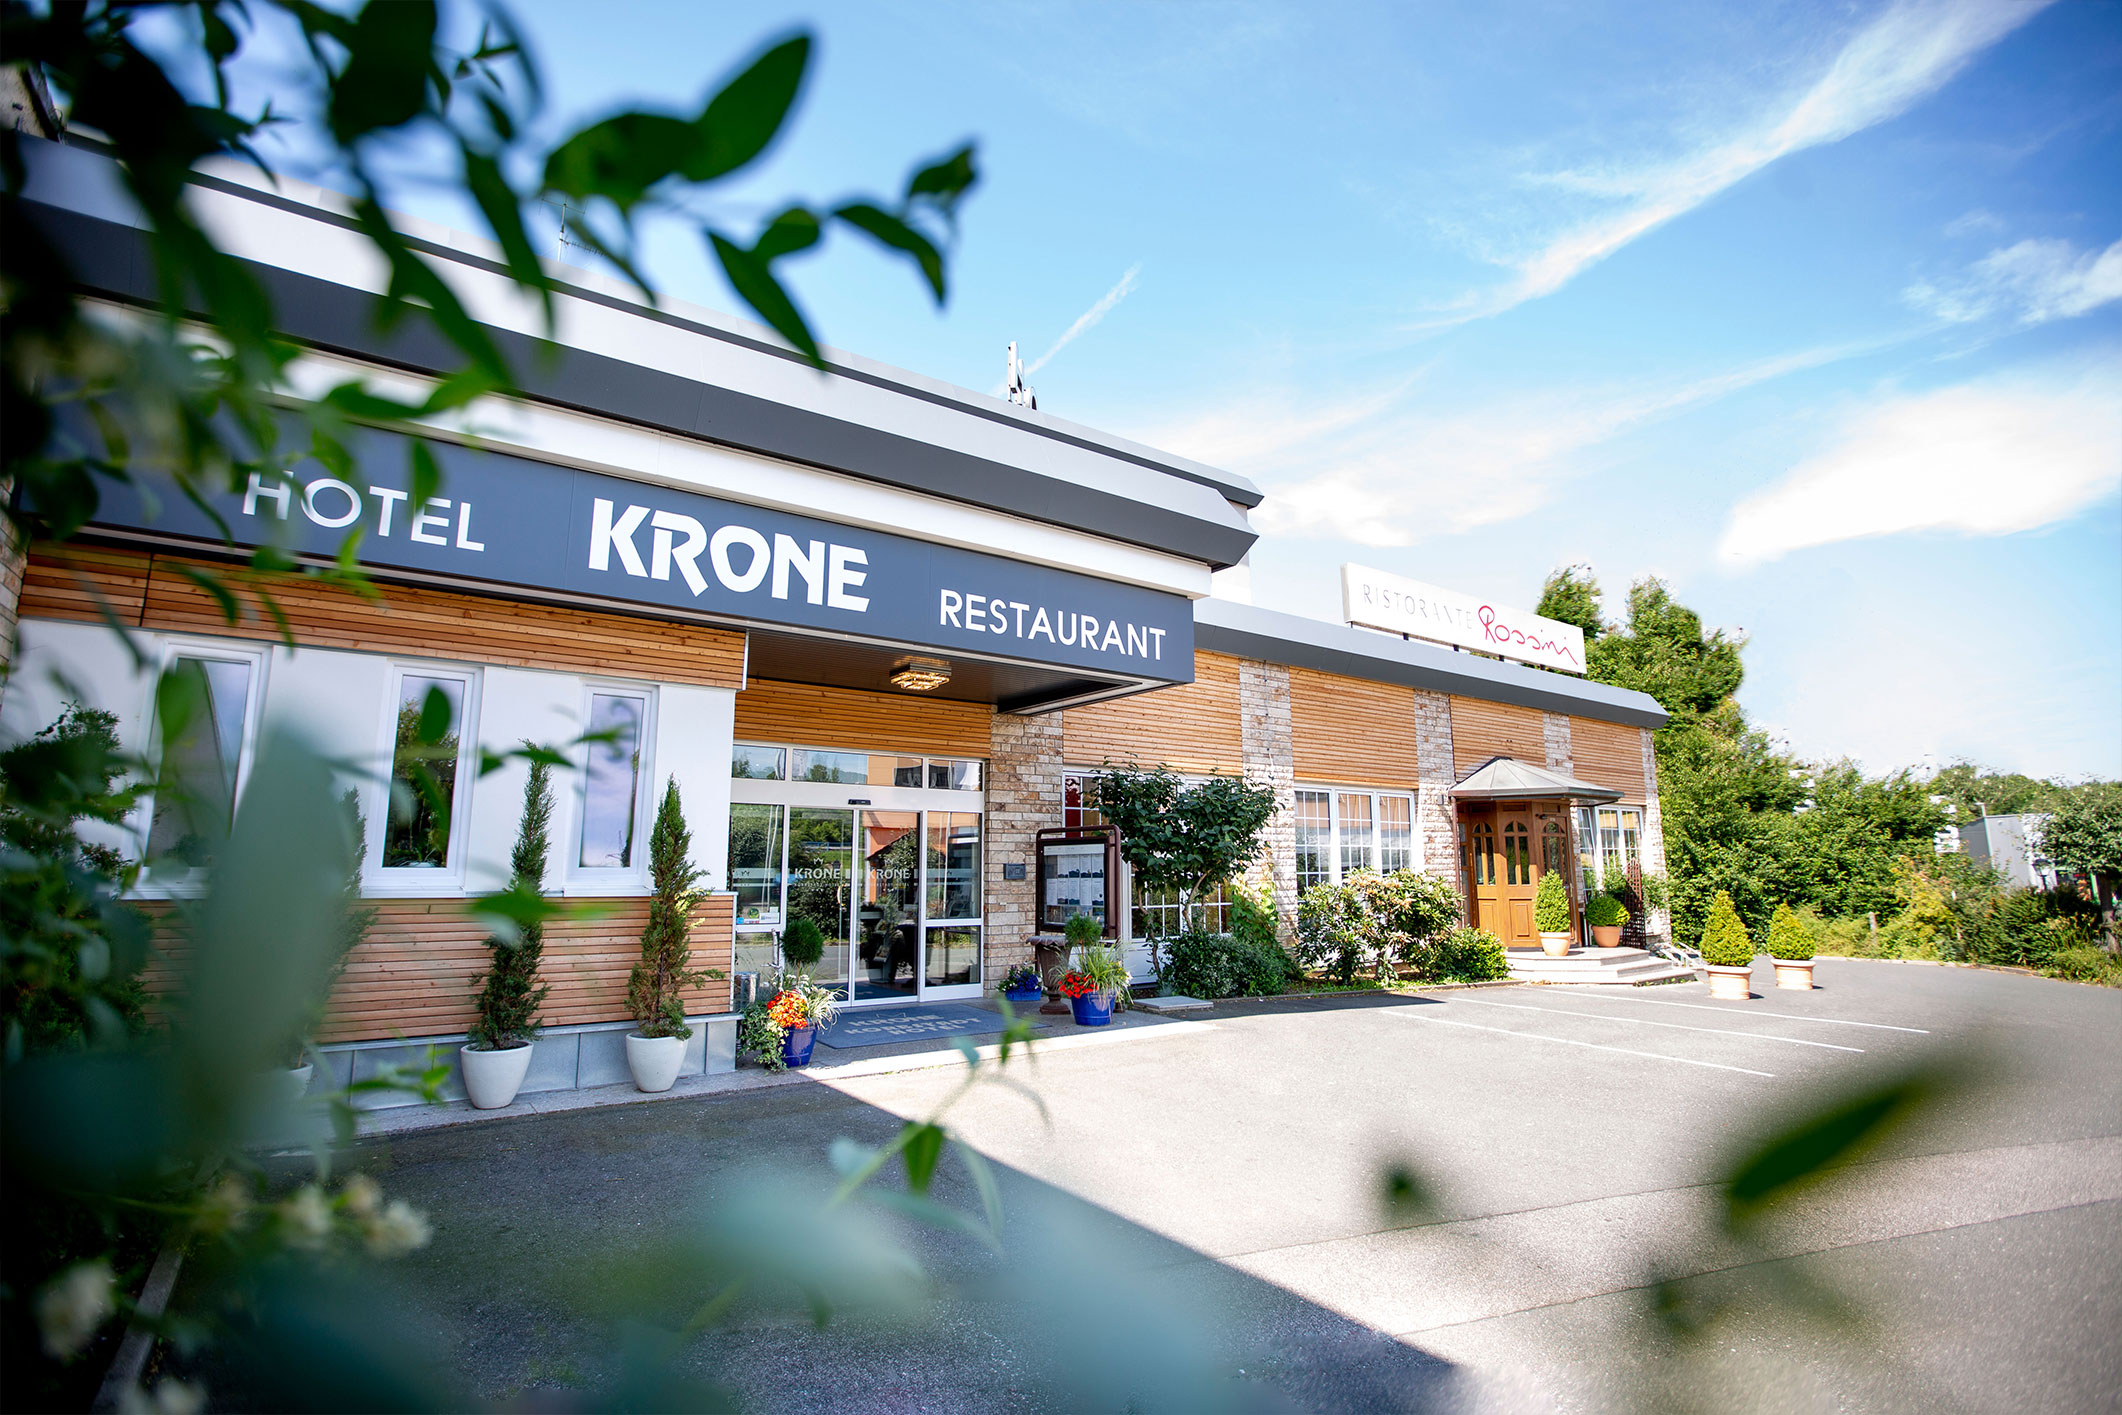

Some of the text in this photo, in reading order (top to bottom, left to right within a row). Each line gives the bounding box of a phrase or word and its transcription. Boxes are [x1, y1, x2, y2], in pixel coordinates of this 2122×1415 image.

[242, 470, 1167, 660] HOTEL KRONE RESTAURANT
[1362, 583, 1473, 630] RISTORANTE
[794, 867, 840, 880] KRONE
[869, 868, 911, 880] KRONE
